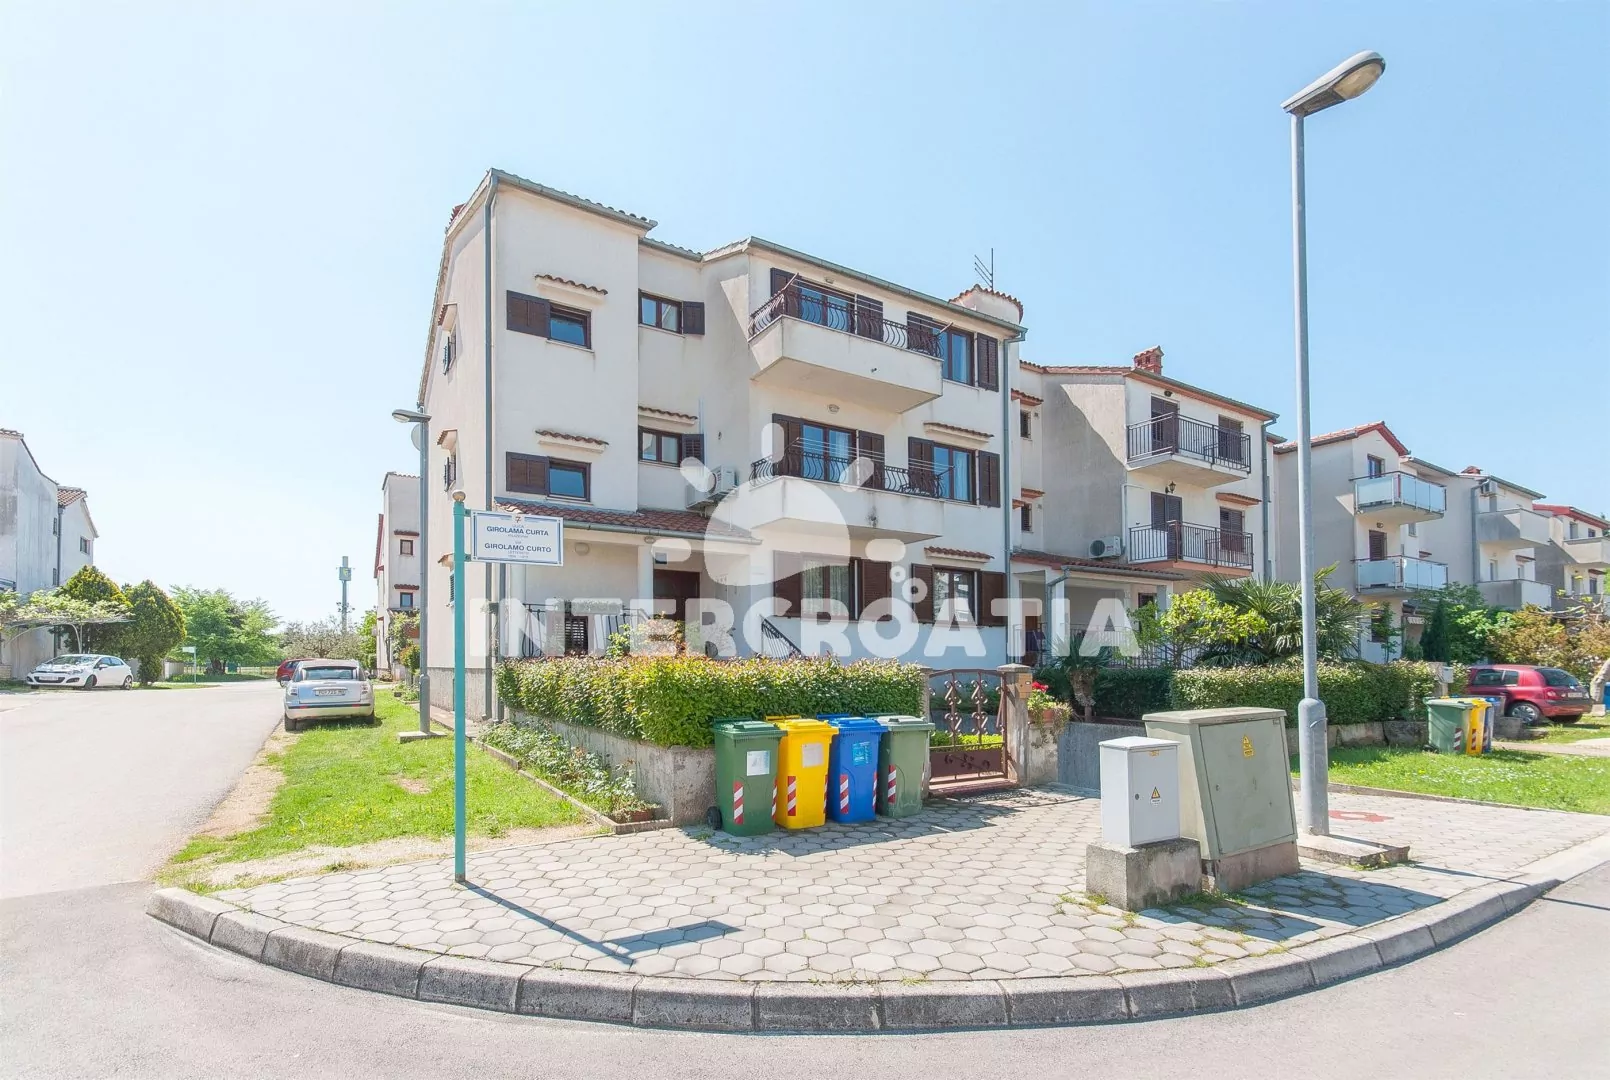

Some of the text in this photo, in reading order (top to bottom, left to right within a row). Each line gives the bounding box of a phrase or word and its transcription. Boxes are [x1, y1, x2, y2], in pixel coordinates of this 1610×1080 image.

[486, 525, 524, 534] GIROLAMA
[525, 528, 549, 536] CURTA
[484, 542, 552, 553] GIROLAMO CURTO
